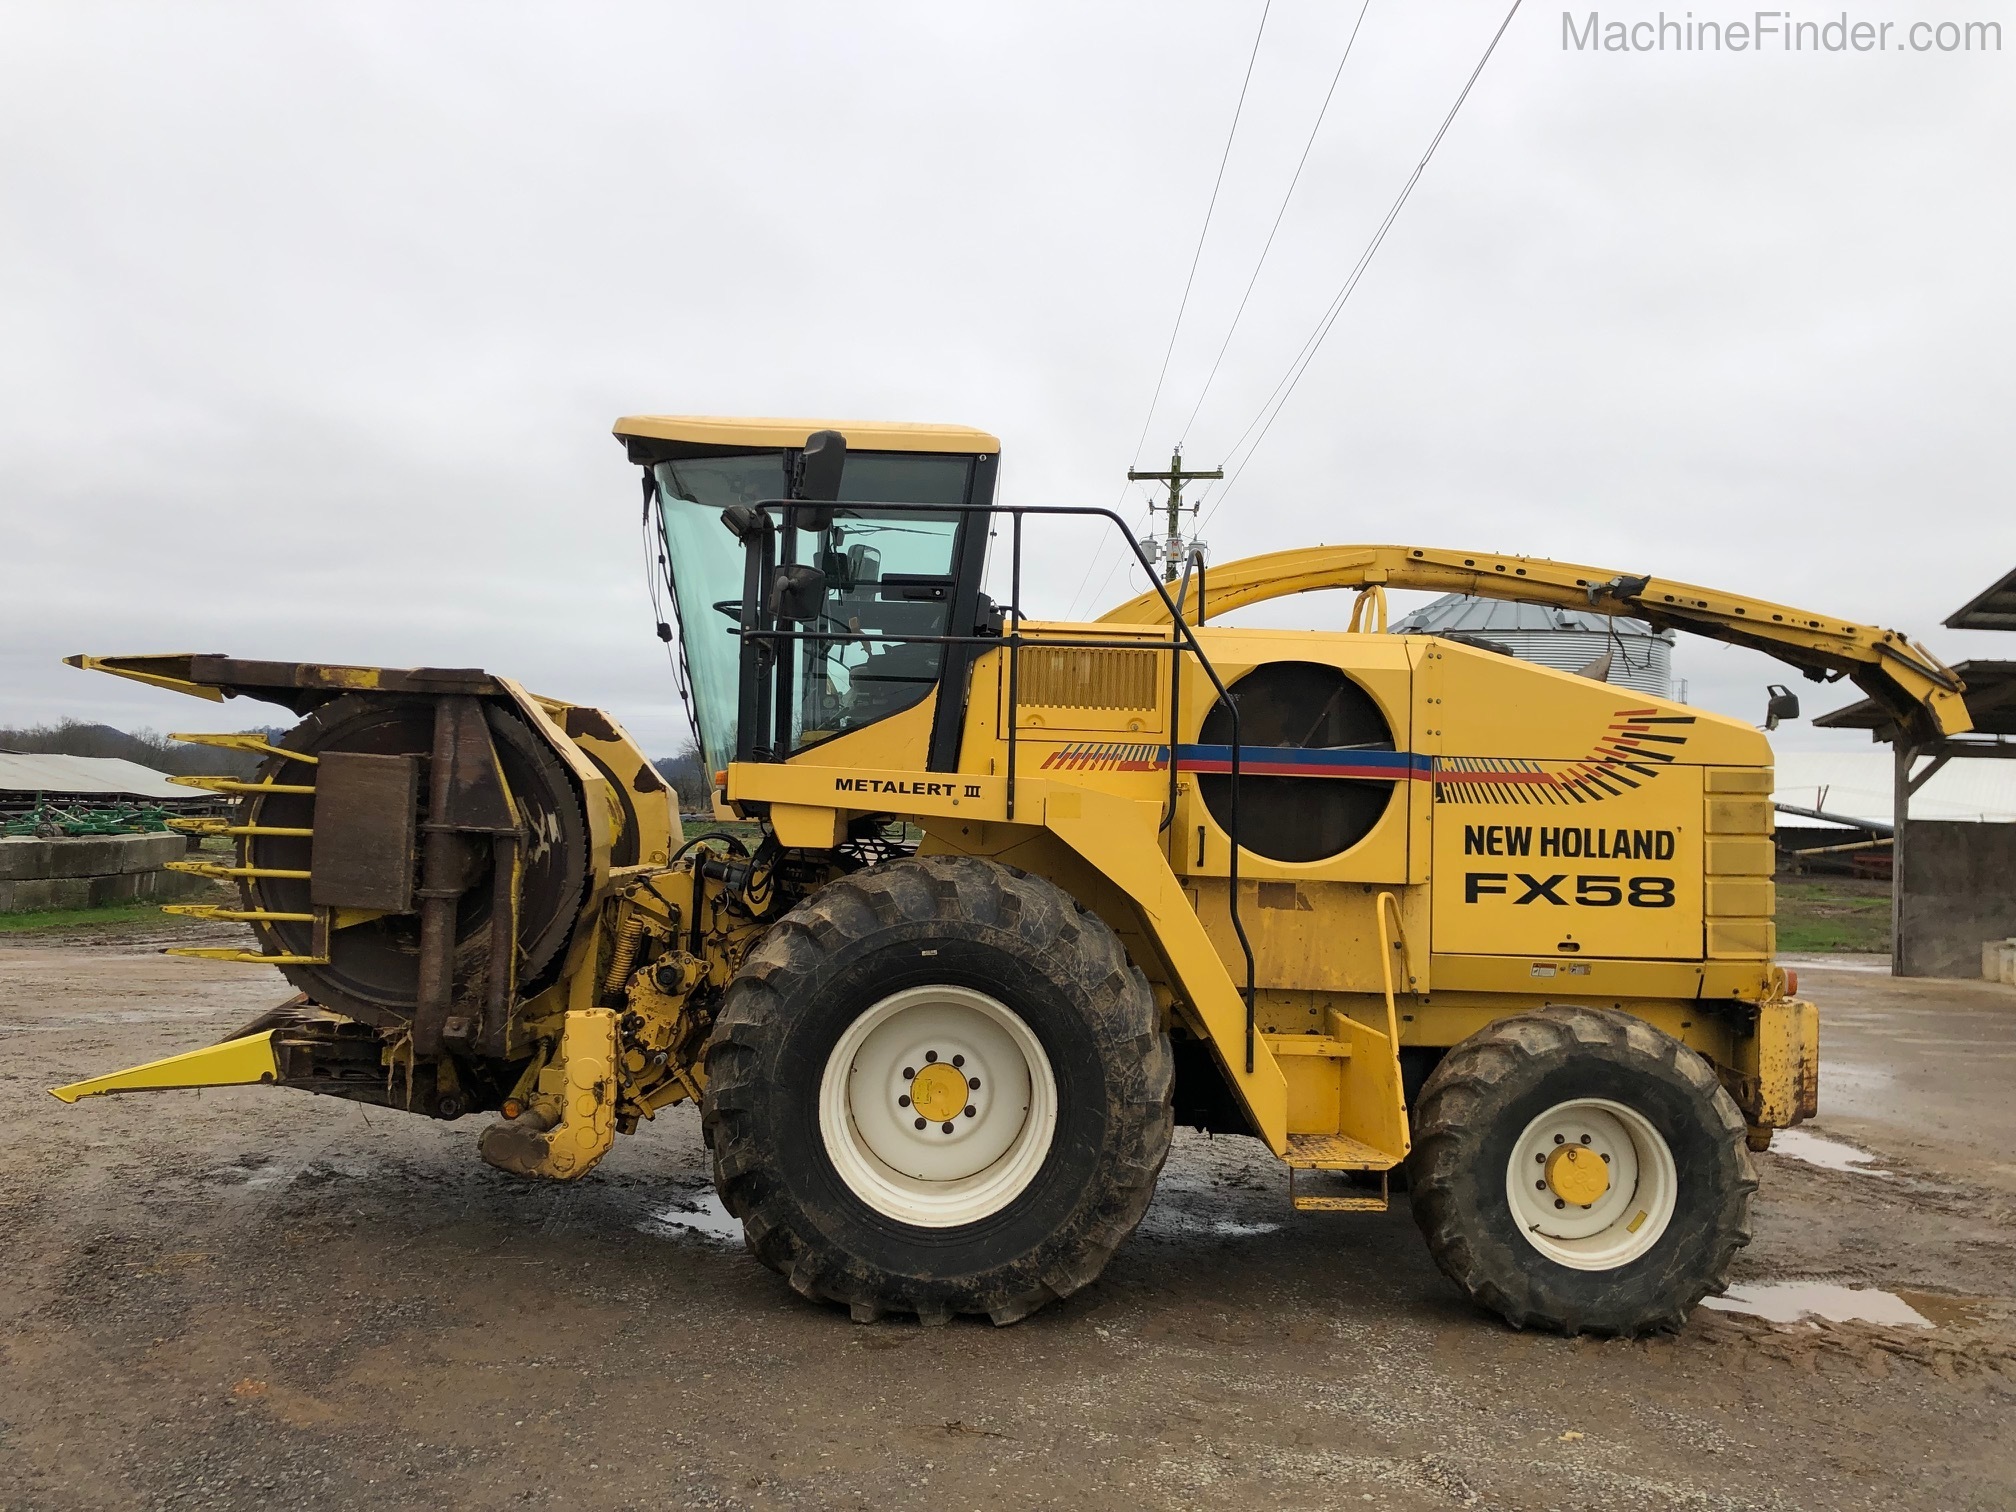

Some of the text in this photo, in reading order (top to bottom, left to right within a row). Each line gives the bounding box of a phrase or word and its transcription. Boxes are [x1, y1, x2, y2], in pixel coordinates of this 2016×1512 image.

[835, 778, 981, 798] METALERT III
[1464, 825, 1675, 860] NEW HOLLAND
[1464, 872, 1676, 908] FX58
